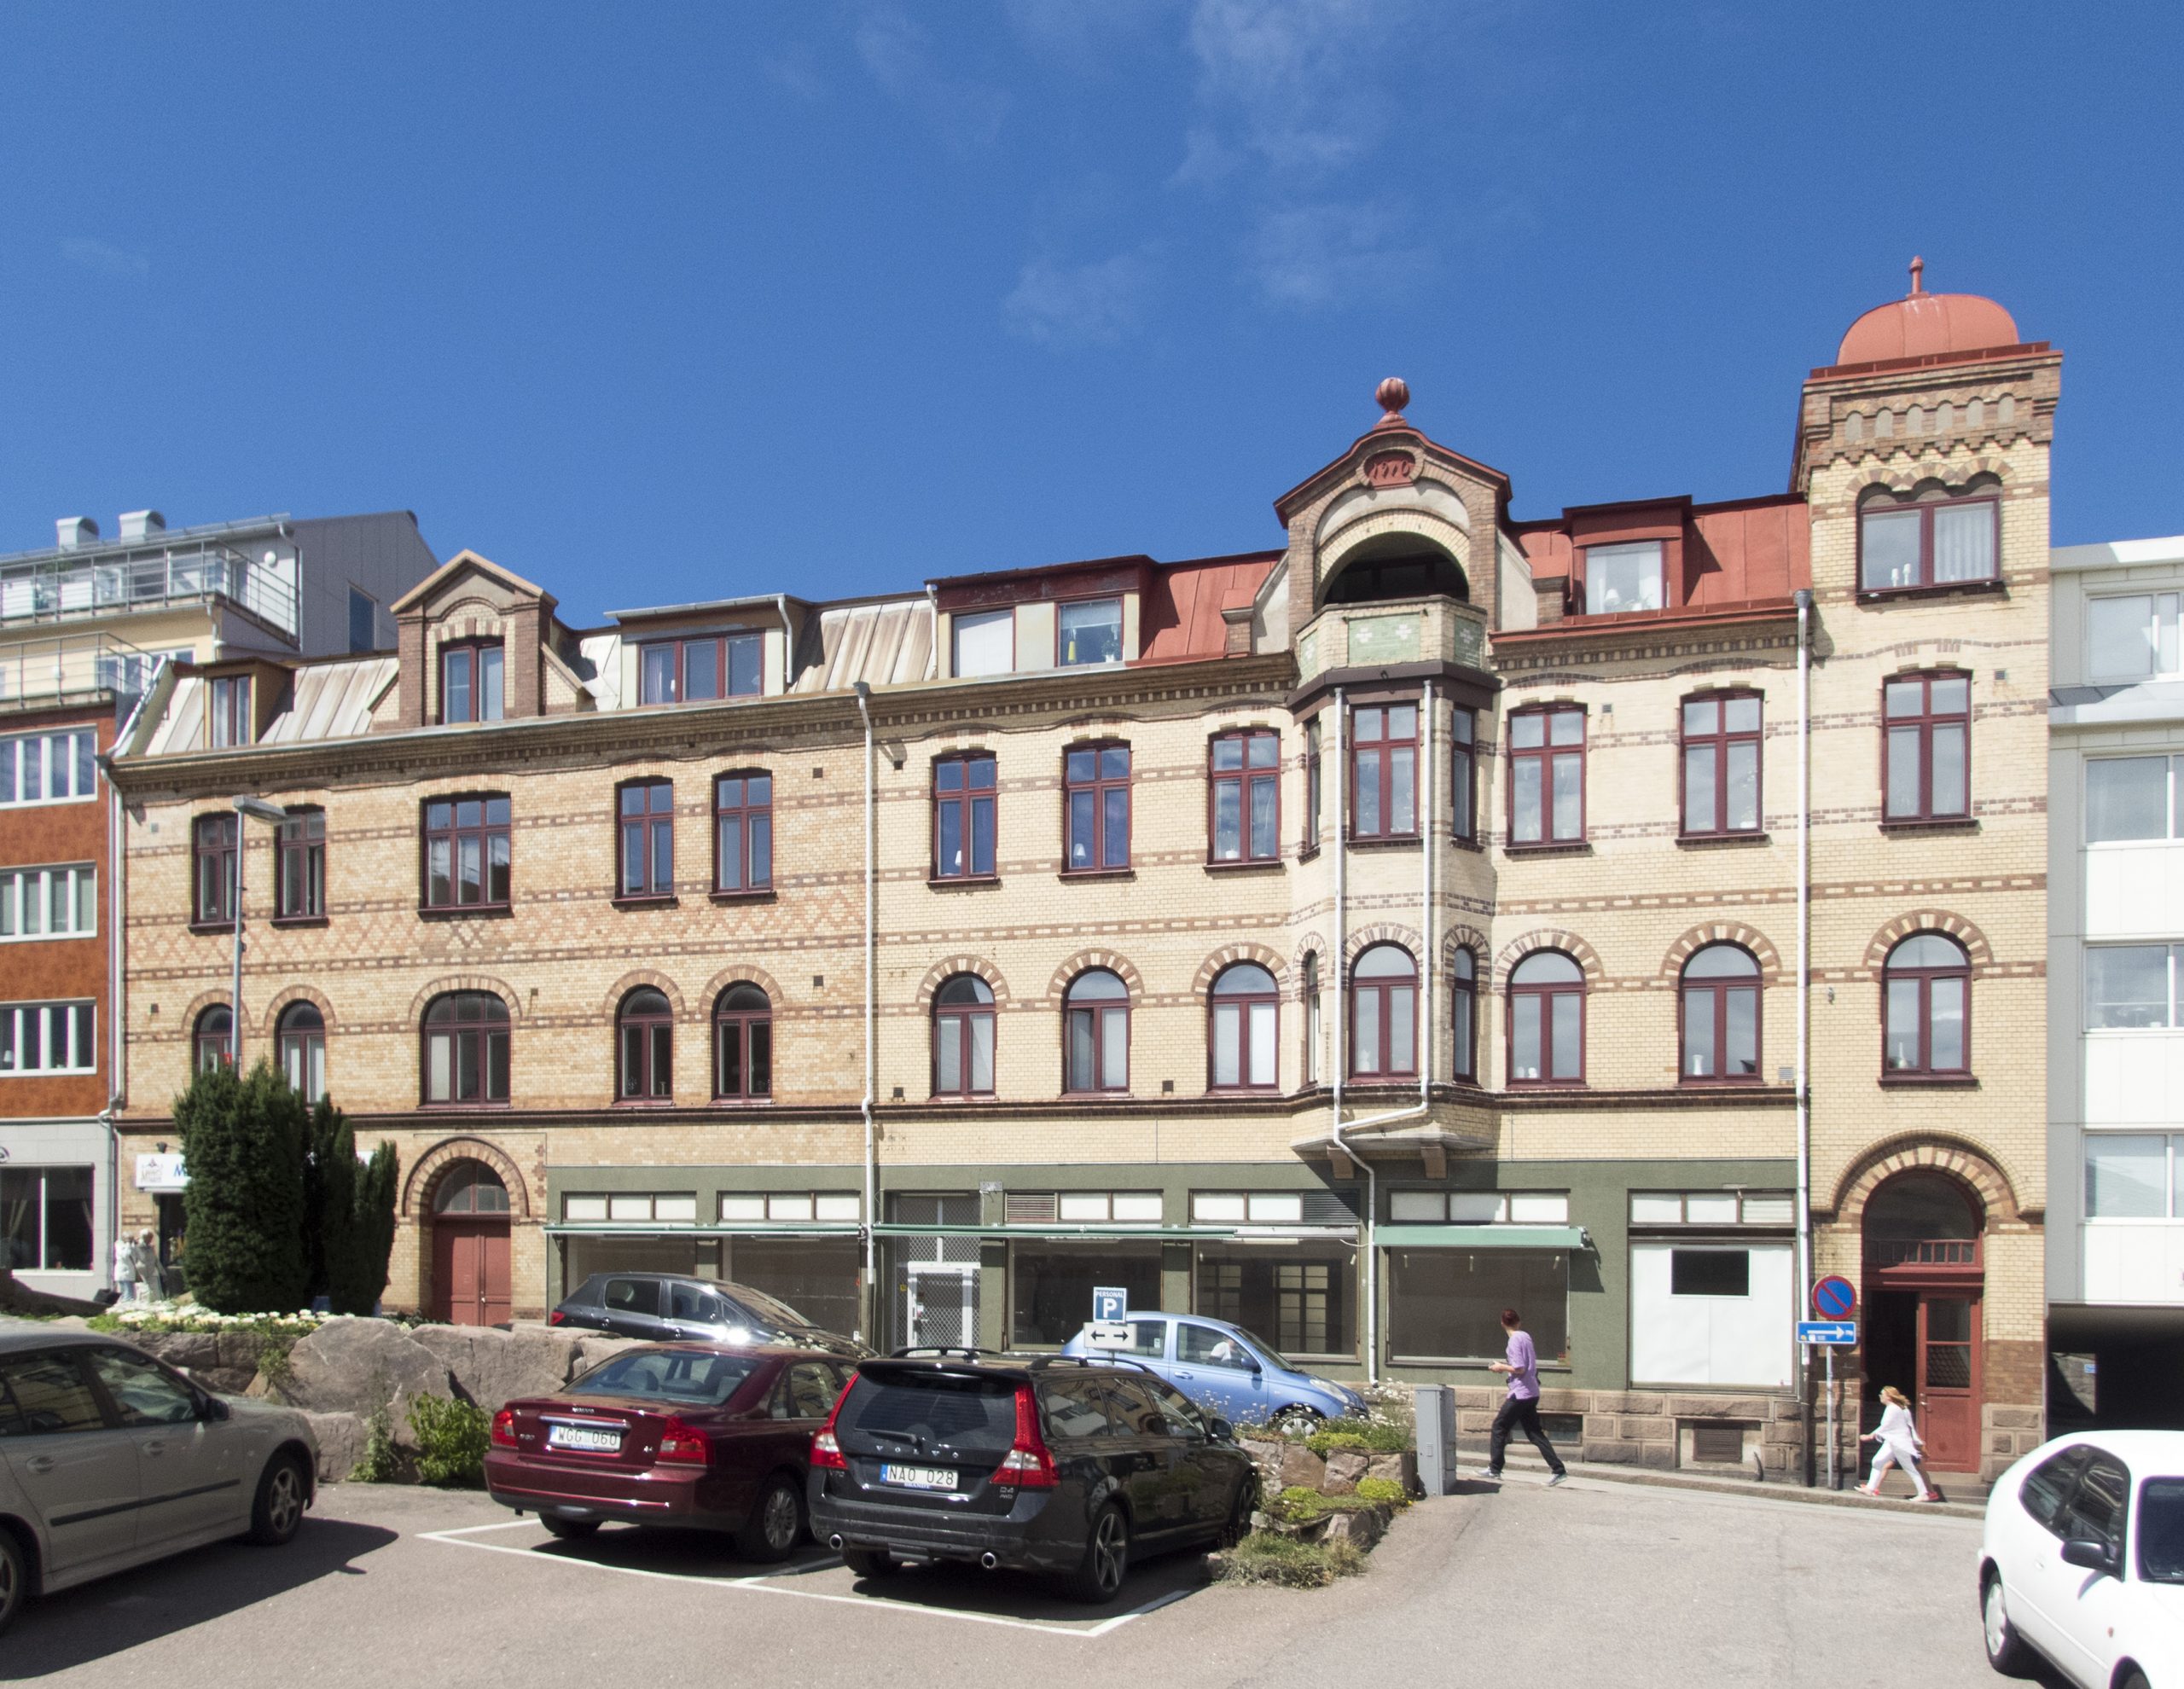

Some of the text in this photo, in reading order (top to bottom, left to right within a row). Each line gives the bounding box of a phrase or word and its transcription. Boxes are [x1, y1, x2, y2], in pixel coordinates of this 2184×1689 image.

[1103, 1297, 1117, 1319] P
[558, 1427, 617, 1447] WGG 060
[875, 1445, 960, 1459] VOLVO
[889, 1466, 954, 1486] NAO 028
